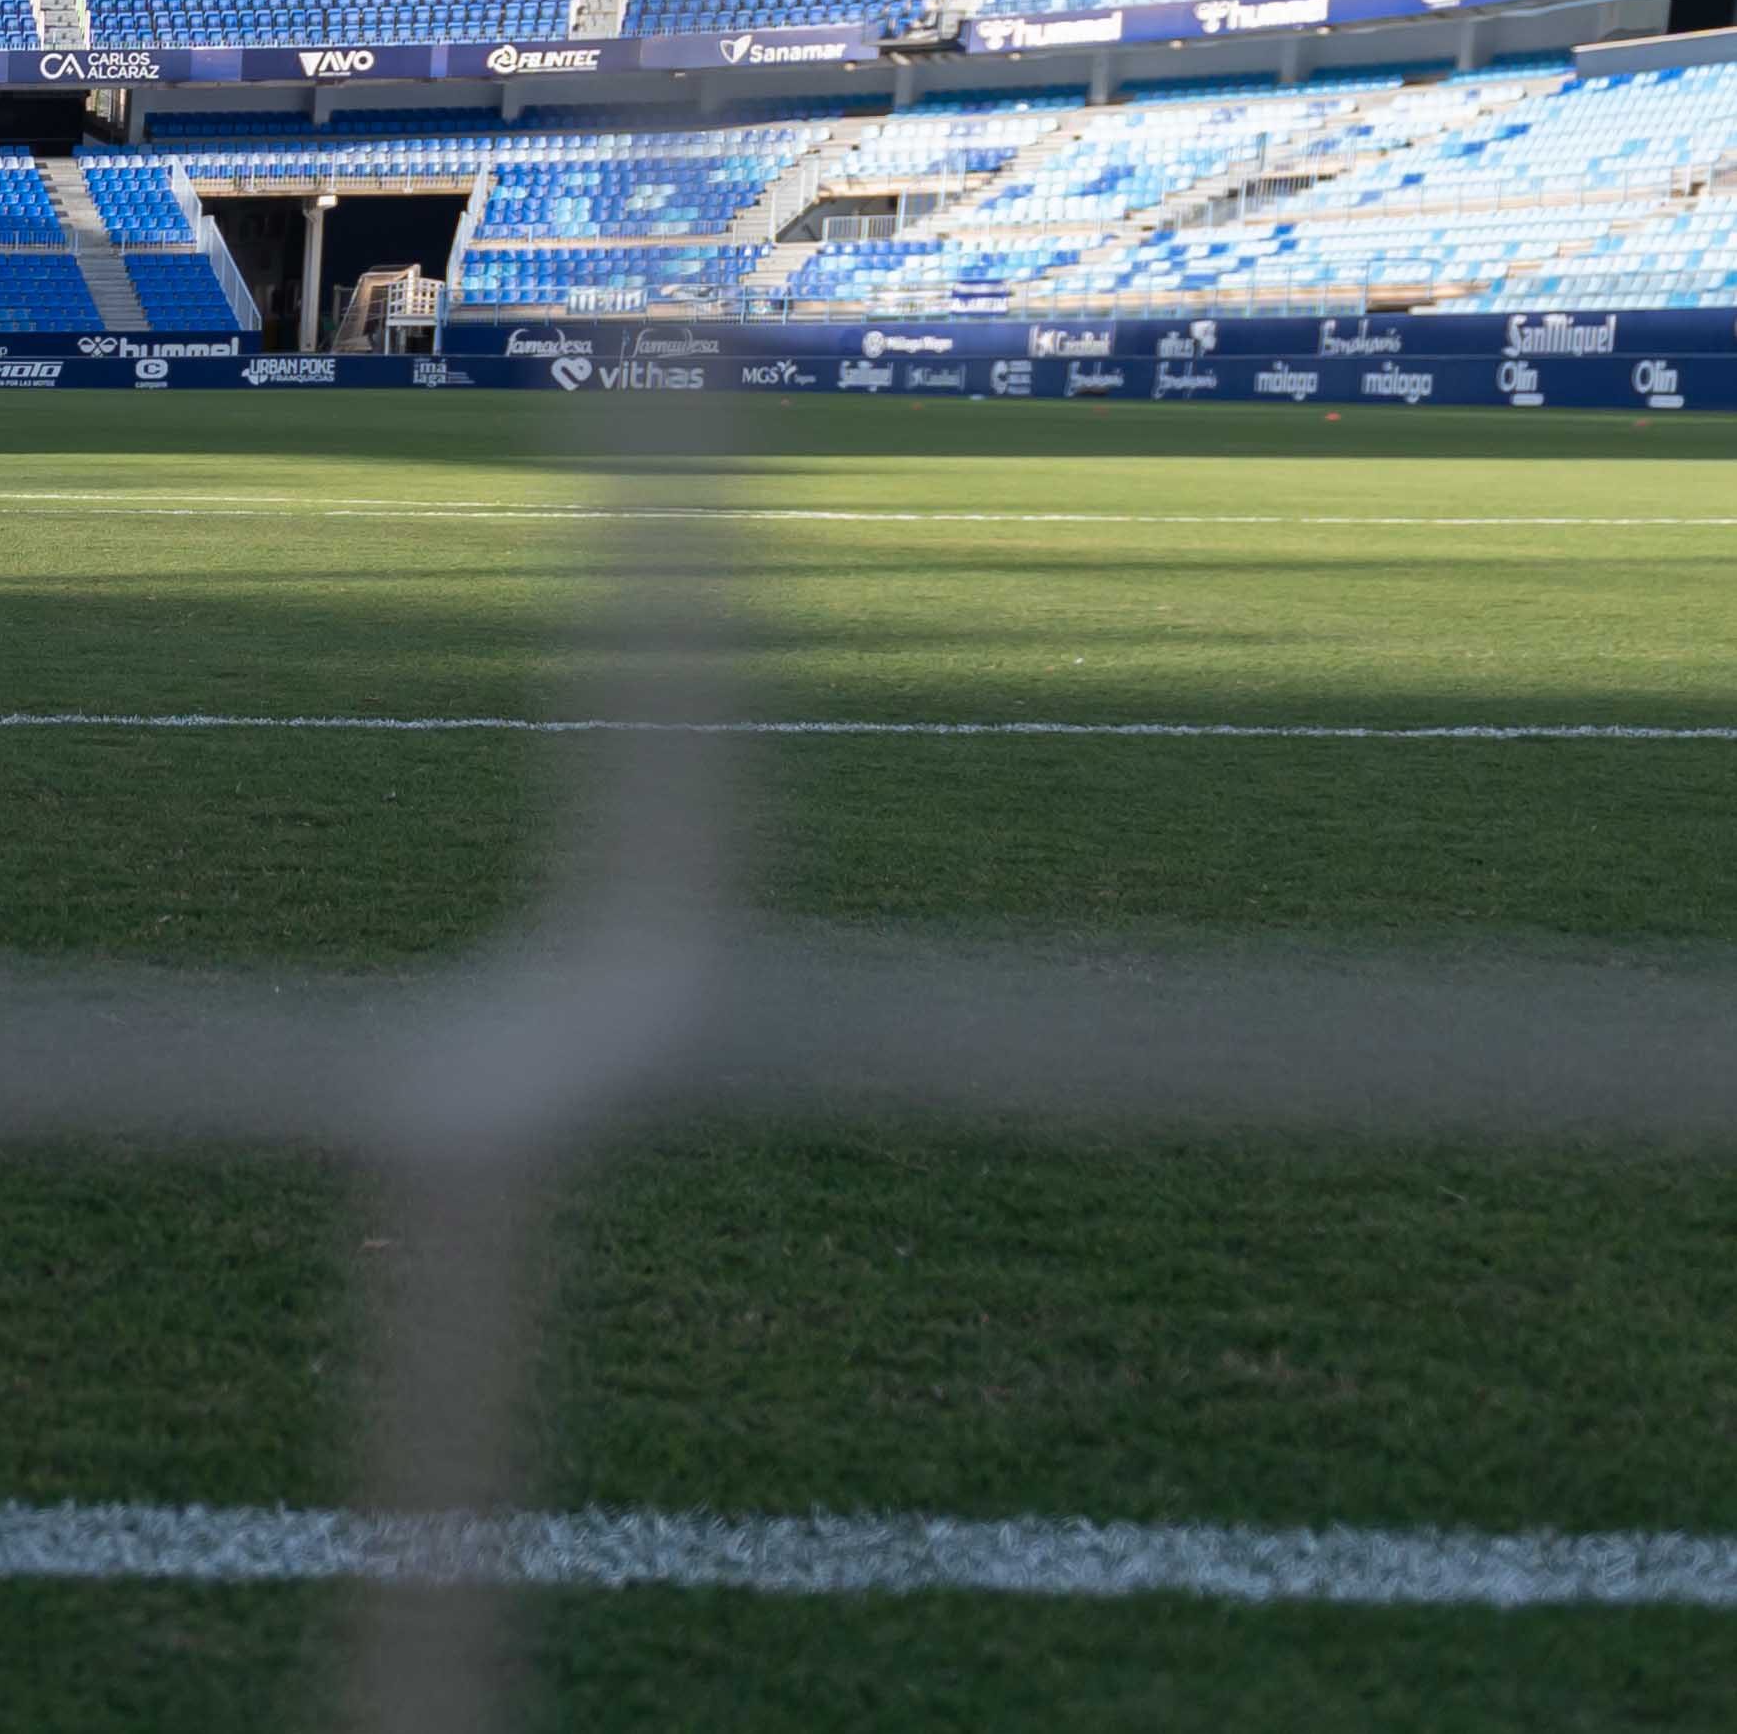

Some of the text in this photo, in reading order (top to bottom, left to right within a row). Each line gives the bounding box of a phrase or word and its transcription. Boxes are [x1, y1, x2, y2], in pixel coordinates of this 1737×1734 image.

[87, 53, 151, 66] CARLOS
[749, 43, 846, 63] Sanamar
[87, 65, 161, 79] ALCARAZ
[120, 337, 239, 357] hummel
[250, 359, 335, 374] URBAN POKE
[599, 361, 704, 389] vithas
[742, 367, 780, 384] MGS
